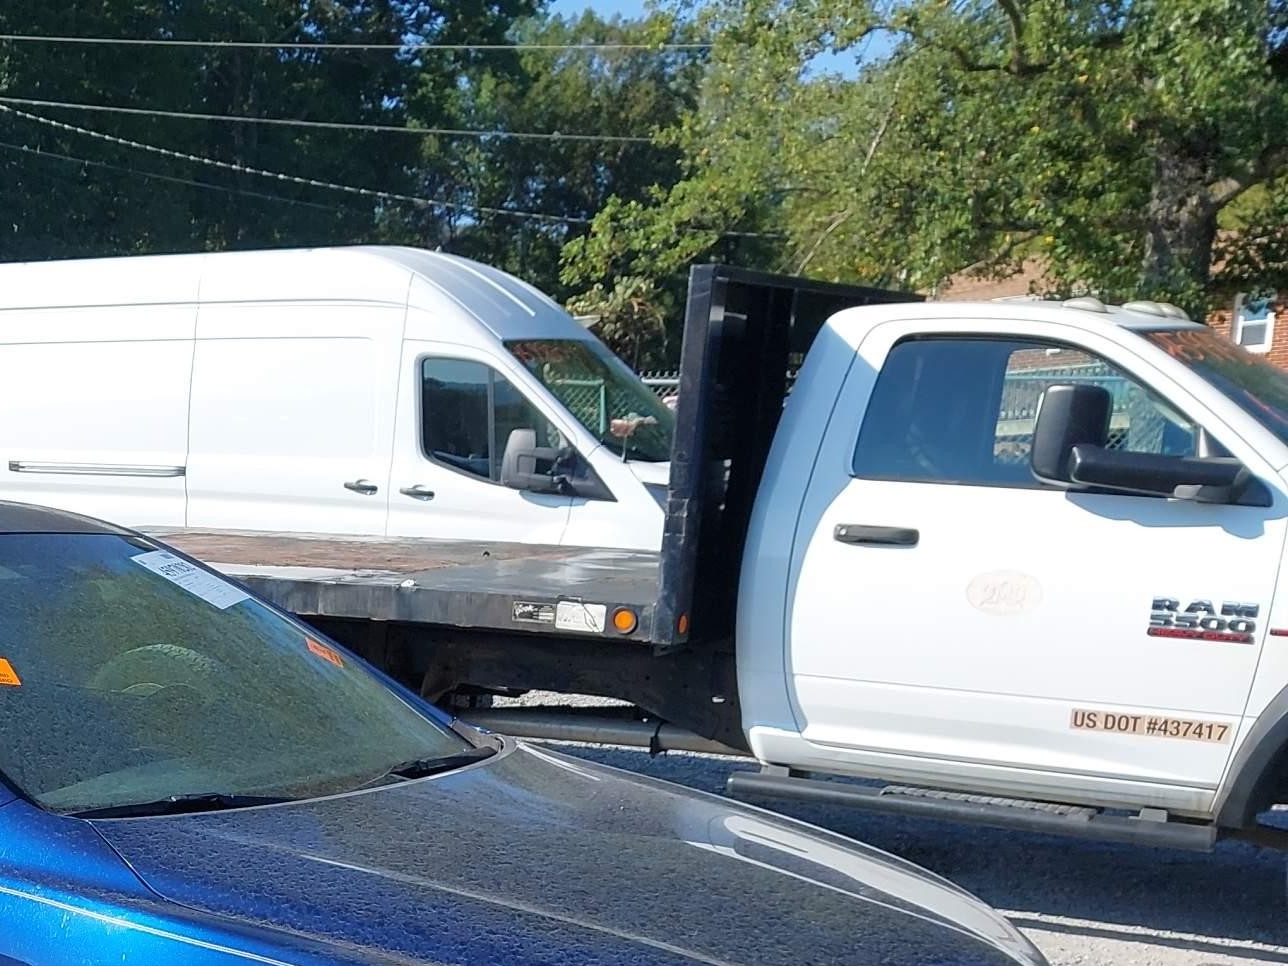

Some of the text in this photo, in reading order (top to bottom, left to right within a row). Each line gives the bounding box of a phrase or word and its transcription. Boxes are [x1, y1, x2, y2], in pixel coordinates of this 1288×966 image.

[1152, 597, 1259, 617] RAM
[1149, 612, 1256, 633] 5500
[1073, 711, 1228, 741] US DOT #437417
